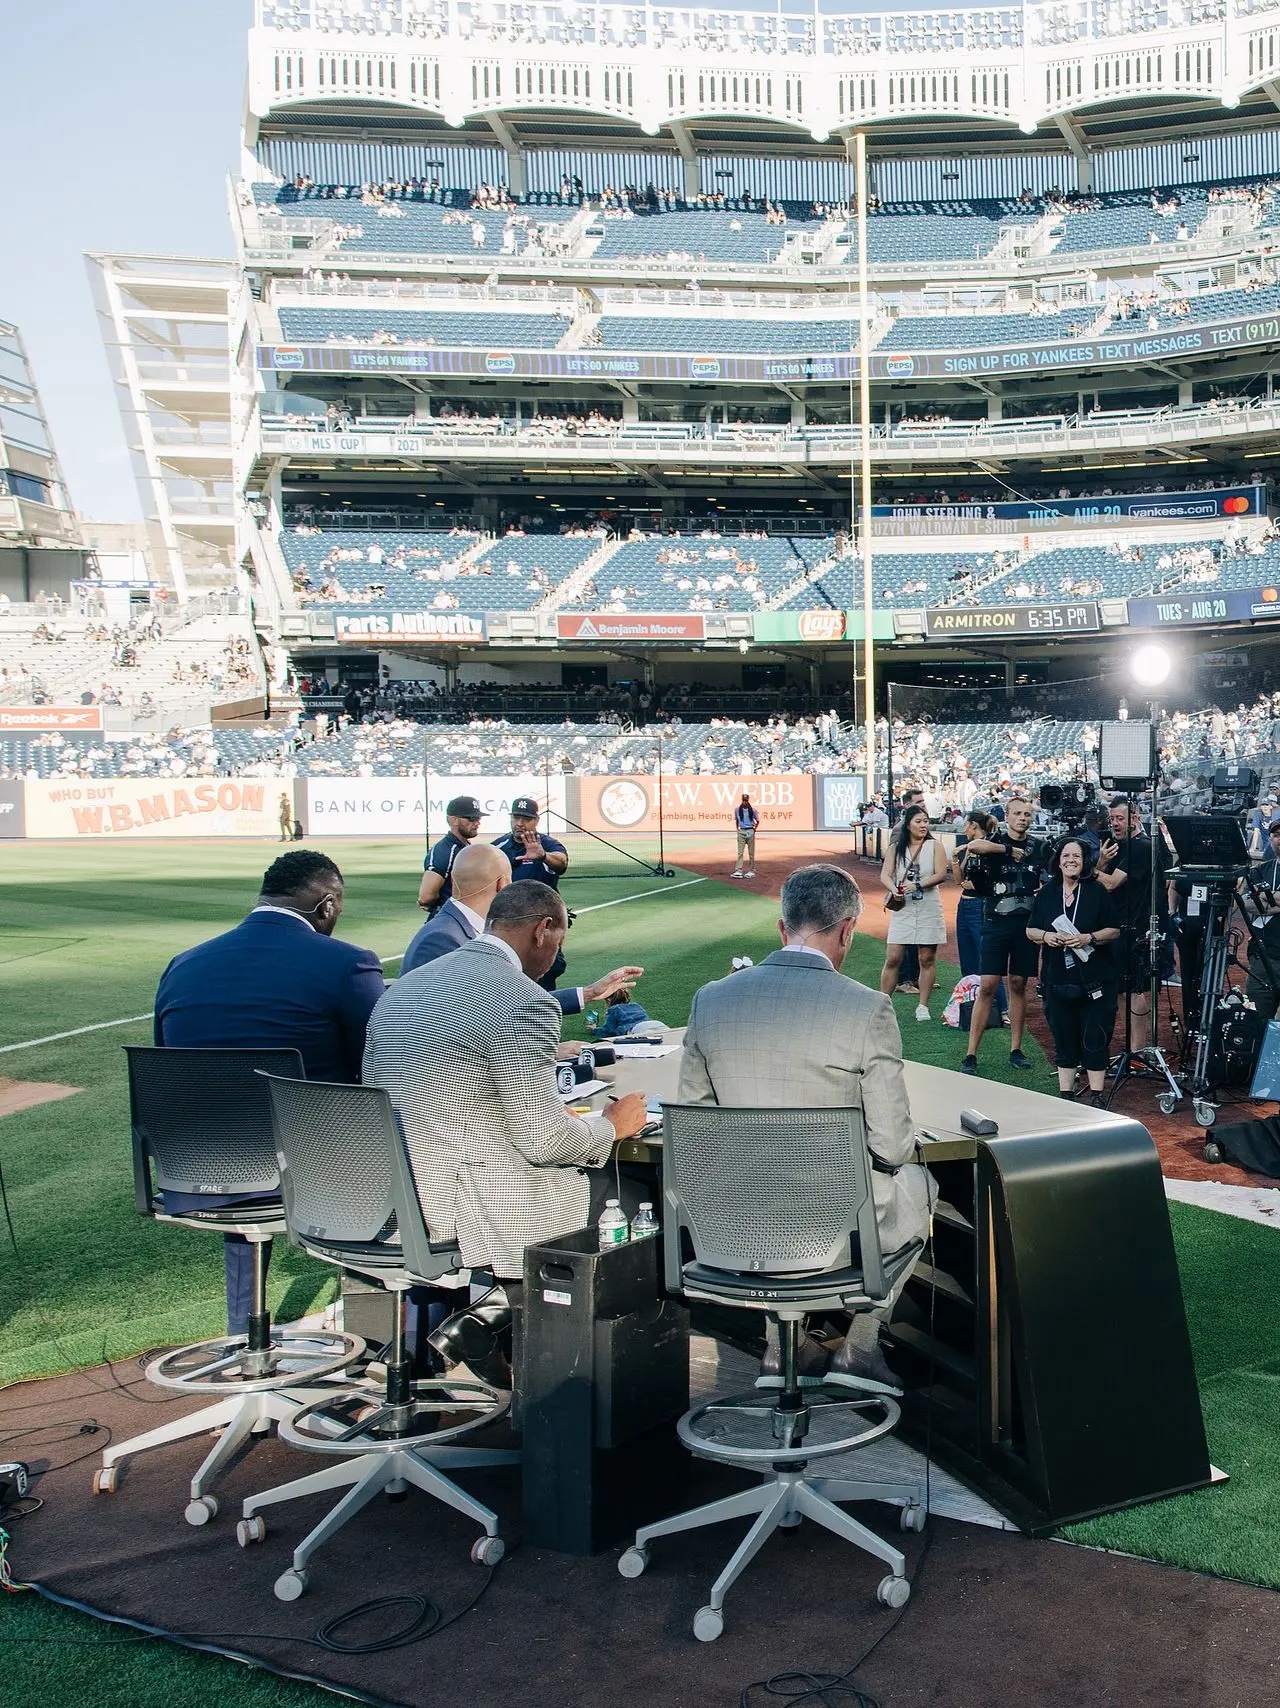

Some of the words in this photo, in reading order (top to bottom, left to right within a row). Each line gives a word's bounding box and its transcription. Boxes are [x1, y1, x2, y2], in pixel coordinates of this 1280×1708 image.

[944, 356, 978, 374] SIGN
[980, 355, 1000, 371] UP
[1003, 352, 1029, 368] FOR
[1032, 347, 1094, 366] YANKEES
[1097, 344, 1130, 360] TEXT
[1133, 334, 1202, 357] MESSAGES
[1210, 327, 1243, 345] TEXT
[1245, 320, 1279, 342] (917)
[275, 353, 304, 364] PEPSI
[353, 355, 377, 367] LET'S
[377, 356, 392, 367] GO
[394, 355, 428, 368] YANKEES
[487, 358, 515, 369] PEPSI
[567, 359, 589, 372] LET'S
[589, 360, 601, 372] GO
[602, 360, 640, 373] YANKEES
[692, 363, 719, 373] PEPSI
[766, 363, 789, 376] LET'S
[788, 364, 799, 375] GO
[800, 362, 835, 375] YANKEES
[888, 361, 914, 372] PEPSI
[312, 437, 331, 450] MLS
[340, 438, 360, 451] CUP
[397, 439, 420, 452] 2021
[890, 507, 921, 522] JOHN
[926, 506, 982, 521] STERLING
[986, 506, 996, 520] &
[1028, 509, 1059, 527] TUES
[1073, 507, 1099, 525] AUG
[1103, 505, 1121, 523] 20
[1132, 503, 1213, 521] yankees.com
[910, 520, 969, 535] WALDMAN
[973, 518, 1019, 534] T-SHIRT
[1157, 603, 1182, 621] TUES
[1192, 601, 1211, 619] AUG
[1212, 600, 1227, 617] 20
[336, 614, 390, 634] Parts
[392, 611, 483, 634] Authority
[933, 612, 1016, 630] ARMITRON
[1027, 609, 1065, 629] 6:35
[1067, 607, 1088, 627] PM
[598, 623, 649, 637] Benjamin
[650, 623, 684, 635] Moore
[803, 613, 844, 639] Lay's
[1, 712, 60, 726] Reebok
[49, 790, 81, 803] WHO
[87, 786, 115, 801] BUT
[651, 782, 707, 808] F.W.
[709, 782, 794, 807] WEBB
[831, 783, 857, 797] NEW
[314, 799, 373, 814] BANK
[381, 799, 406, 813] OF
[412, 799, 511, 813] AMCA
[698, 811, 733, 822] Heating,
[770, 811, 776, 821] &
[777, 811, 793, 821] PVF
[1196, 889, 1203, 899] 3
[564, 1072, 572, 1087] FOX
[199, 1184, 223, 1194] SPARE
[753, 1260, 760, 1270] 3
